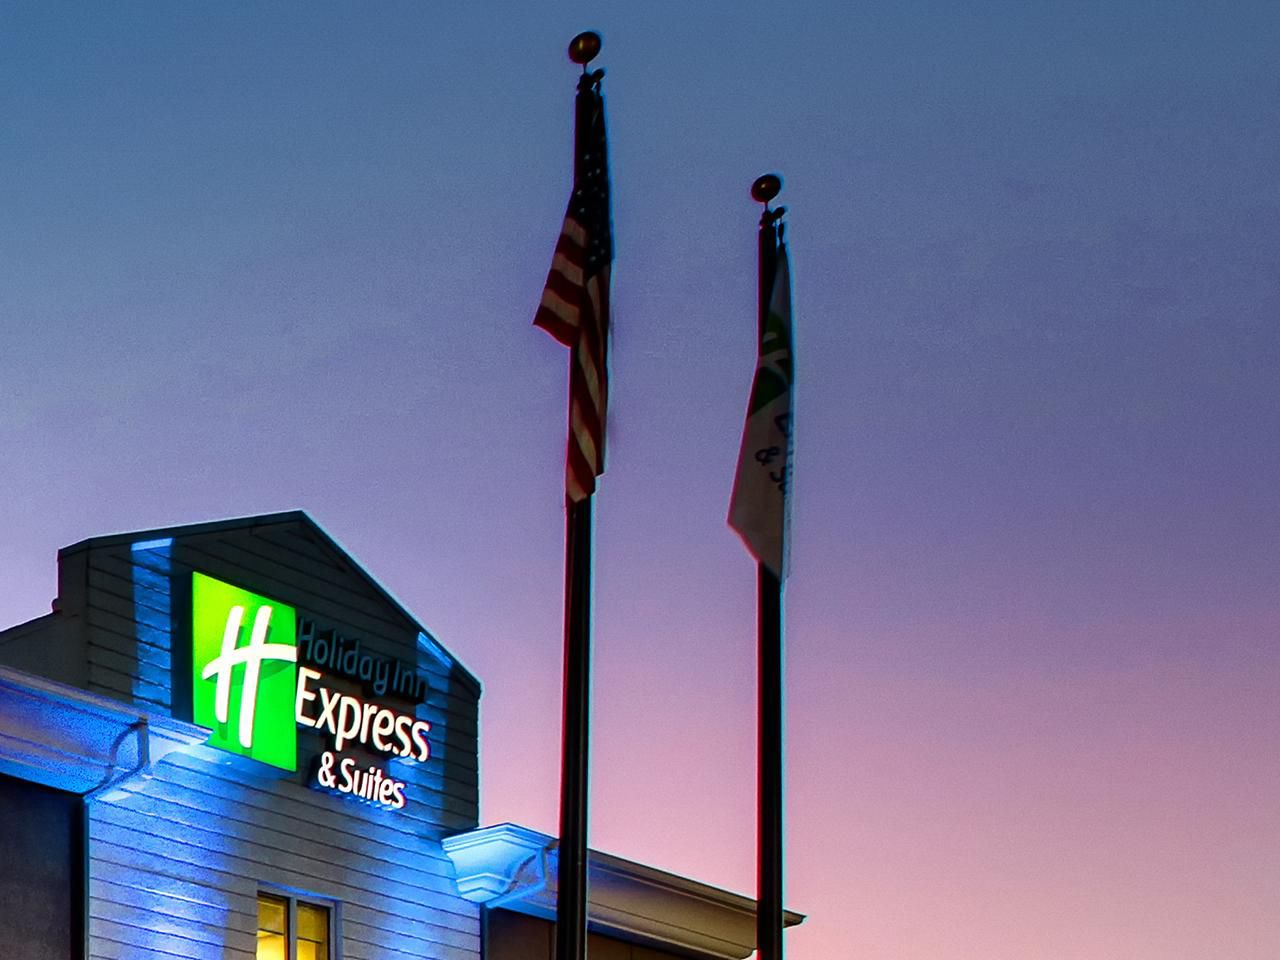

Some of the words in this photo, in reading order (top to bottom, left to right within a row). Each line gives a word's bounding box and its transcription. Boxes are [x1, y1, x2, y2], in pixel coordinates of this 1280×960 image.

[299, 618, 390, 695] Holiday
[393, 660, 429, 698] Inn
[295, 667, 431, 762] Express
[318, 752, 336, 788] &
[338, 759, 406, 808] Suites
